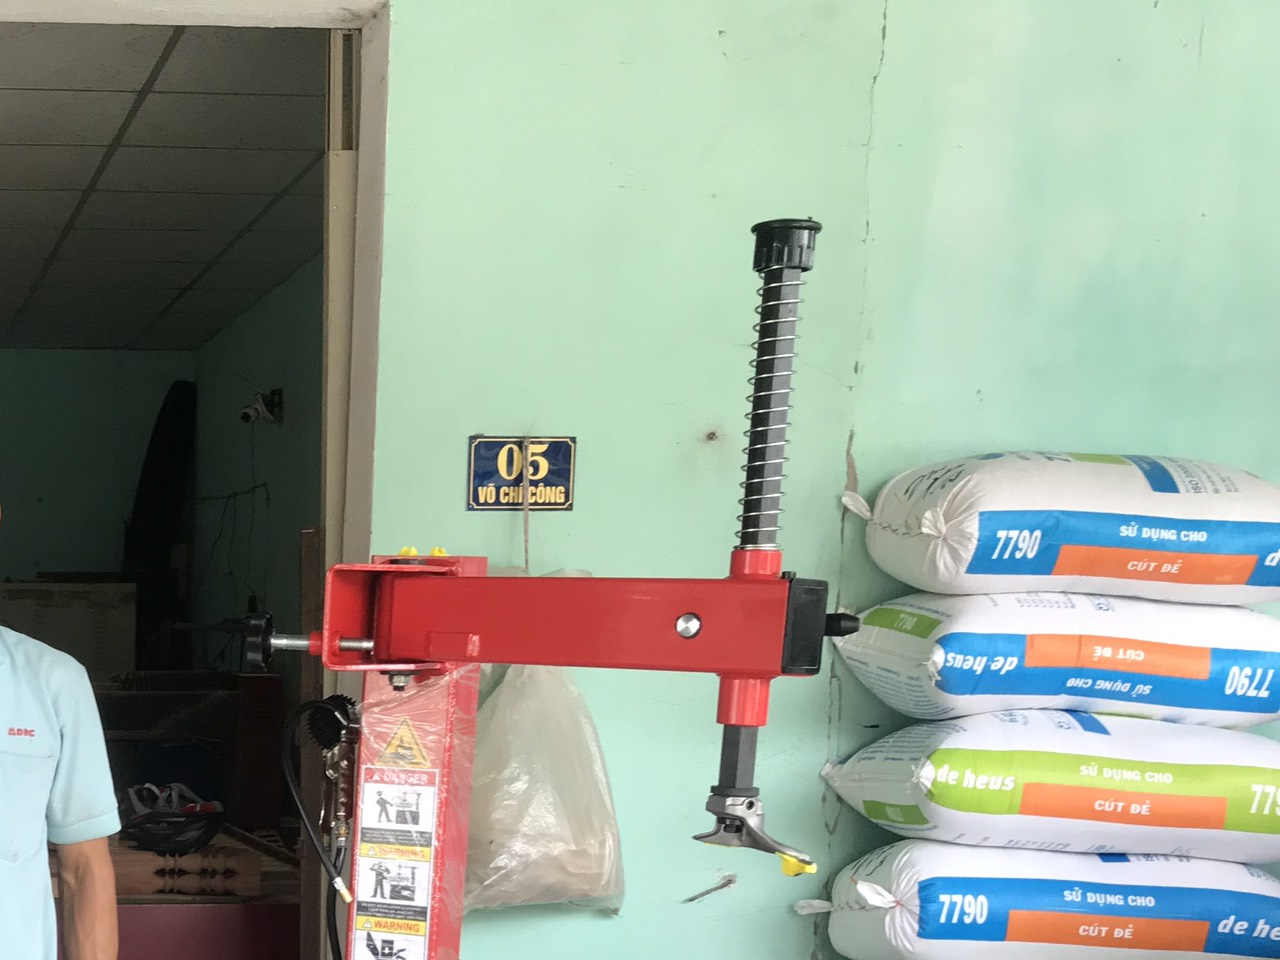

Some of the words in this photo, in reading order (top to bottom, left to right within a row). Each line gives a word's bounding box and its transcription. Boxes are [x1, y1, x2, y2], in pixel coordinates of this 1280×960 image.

[497, 443, 550, 480] 05
[477, 483, 496, 503] VÕ
[499, 483, 524, 503] CHÍ
[527, 482, 566, 504] CÔNG
[1119, 521, 1138, 537] SỬ
[1142, 526, 1177, 542] DỤNG
[1180, 530, 1208, 542] CHO
[991, 529, 1042, 559] 7790
[1127, 559, 1155, 573] CÚT
[945, 652, 987, 674] heus
[990, 655, 1018, 675] de
[1116, 648, 1144, 662] CÚT
[1066, 677, 1092, 688] CHO
[1095, 679, 1131, 692] DỤNG
[1131, 681, 1153, 697] SỬ
[1224, 665, 1275, 698] 7790
[384, 771, 429, 784] DANGER
[936, 764, 958, 784] de
[963, 769, 1016, 791] heus
[1079, 762, 1099, 777] SỬ
[1103, 767, 1142, 782] DỤNG
[1145, 772, 1173, 784] CHO
[1094, 798, 1126, 813] CÚT
[1064, 886, 1082, 902] SỬ
[1086, 892, 1124, 907] DỤNG
[1127, 895, 1156, 907] CHO
[938, 893, 989, 925] 7790
[374, 919, 421, 933] WARNING
[1078, 922, 1108, 938] CÚT
[1217, 915, 1248, 935] de
